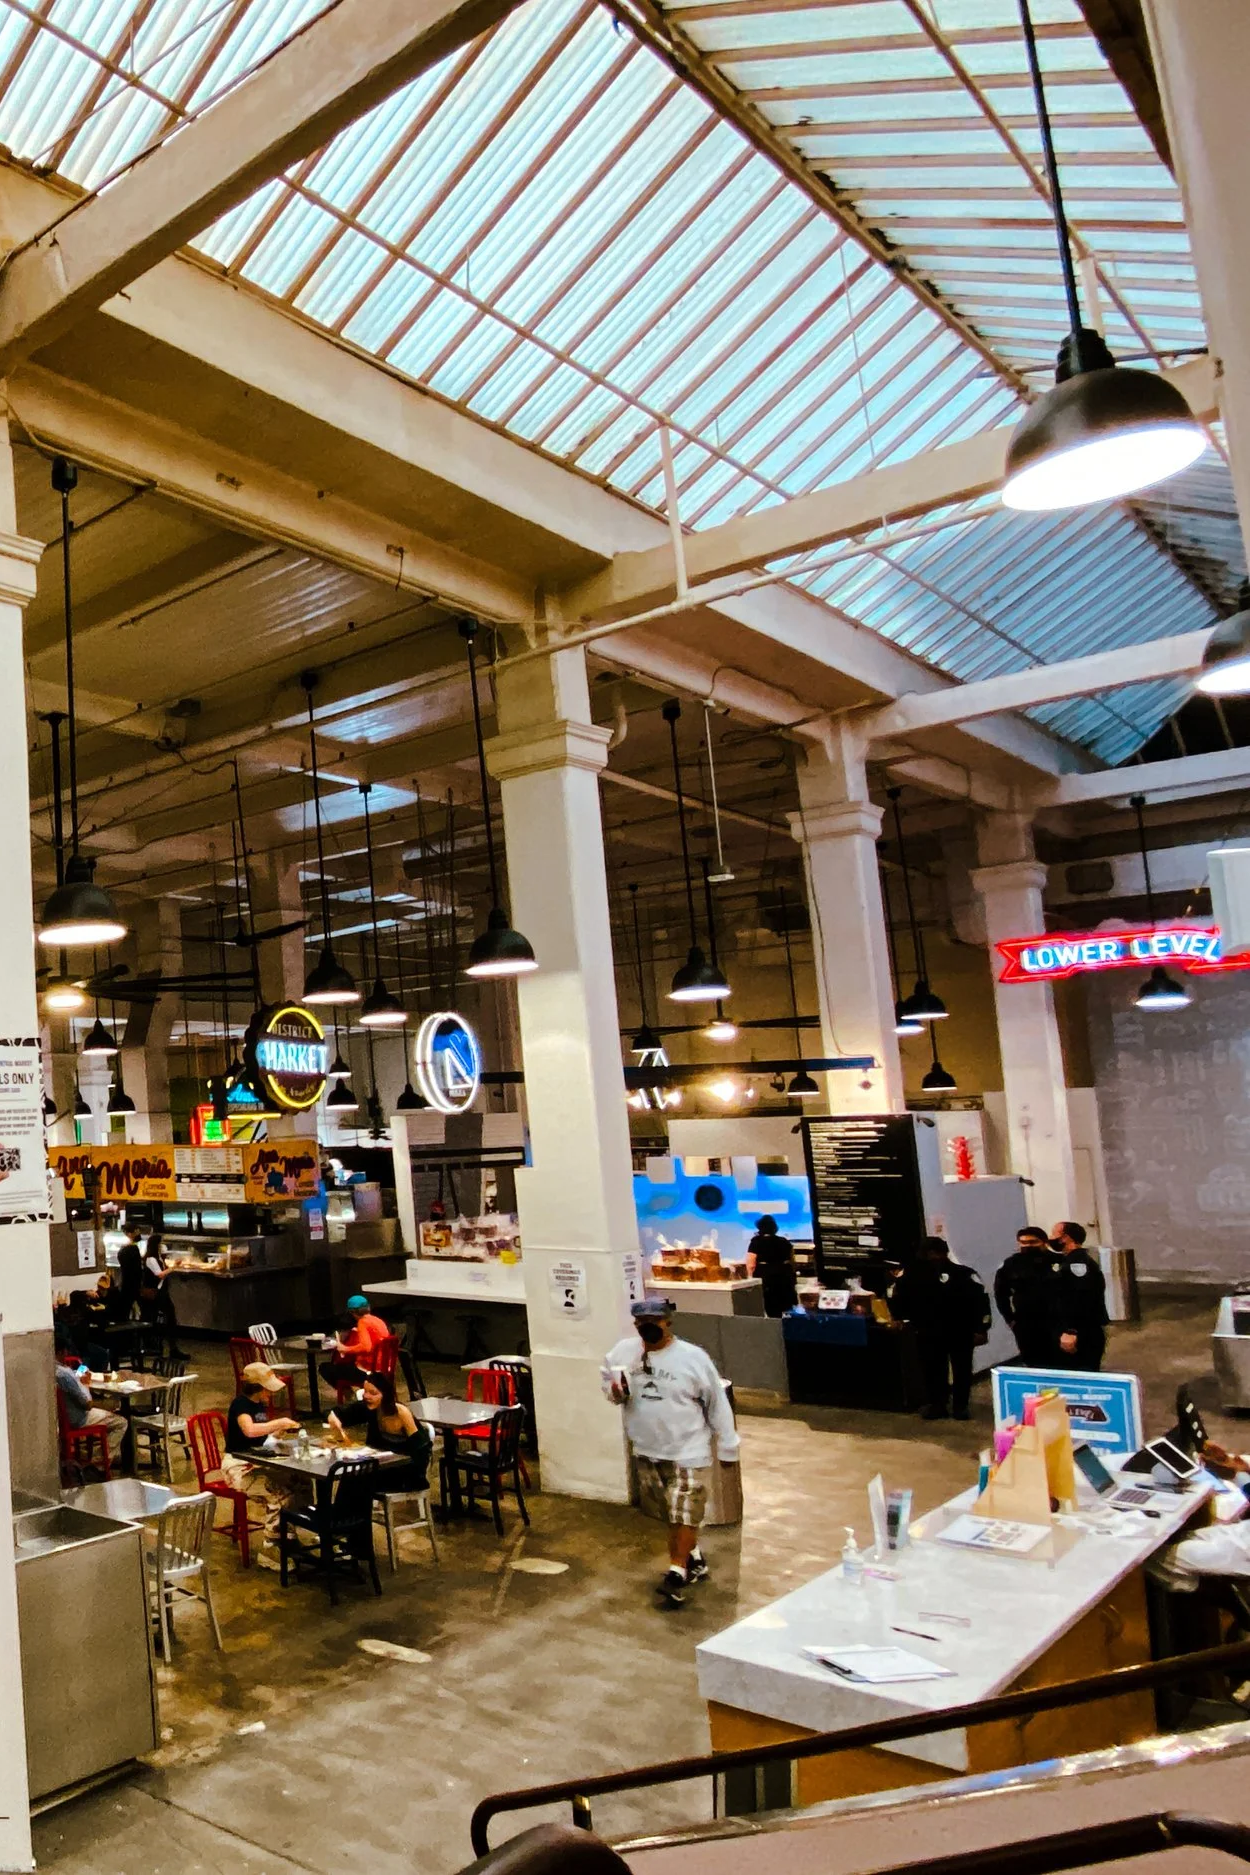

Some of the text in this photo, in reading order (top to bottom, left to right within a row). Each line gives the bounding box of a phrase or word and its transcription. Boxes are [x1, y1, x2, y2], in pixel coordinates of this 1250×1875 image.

[1021, 934, 1221, 973] LOWER LEVEL
[271, 1023, 313, 1038] DISTRICT
[263, 1040, 327, 1074] MARKET
[12, 1072, 34, 1085] ONLY
